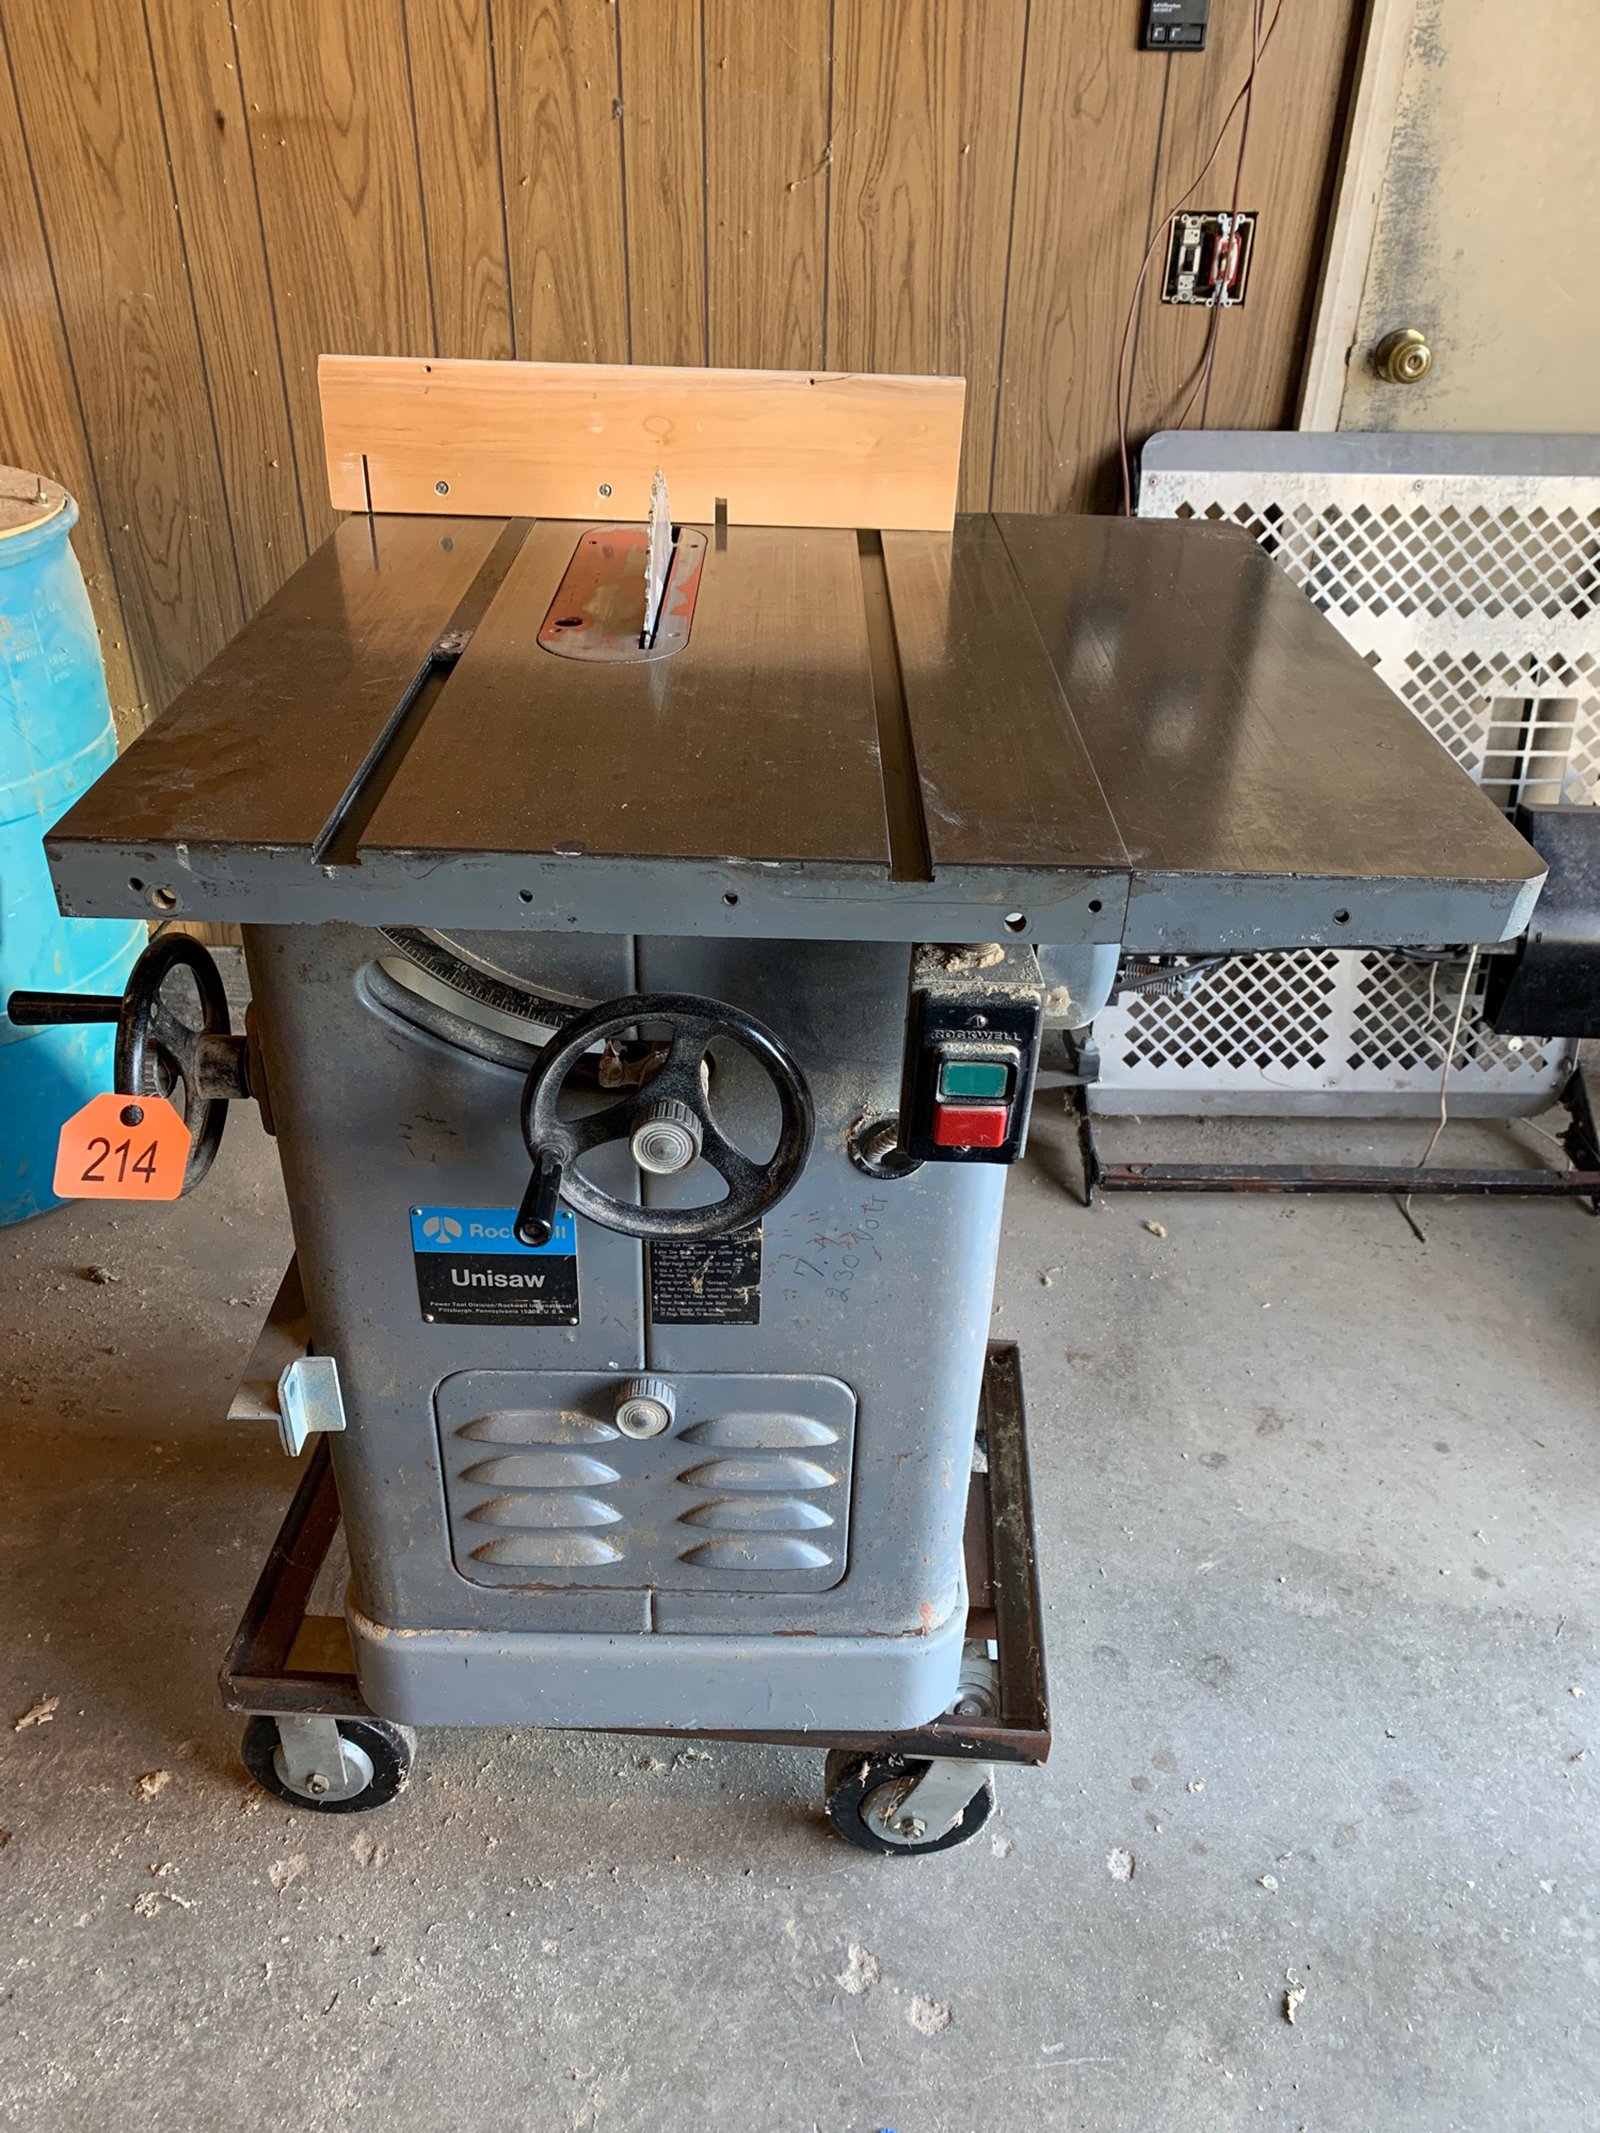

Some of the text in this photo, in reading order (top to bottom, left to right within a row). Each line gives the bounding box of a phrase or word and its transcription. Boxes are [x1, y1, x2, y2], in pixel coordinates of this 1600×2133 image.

[453, 960, 468, 972] 30
[528, 996, 539, 1005] 15
[932, 1029, 1022, 1042] ROCKWELL
[81, 1136, 158, 1184] 214
[469, 1223, 567, 1240] Rocll
[450, 1268, 546, 1288] Unisaw
